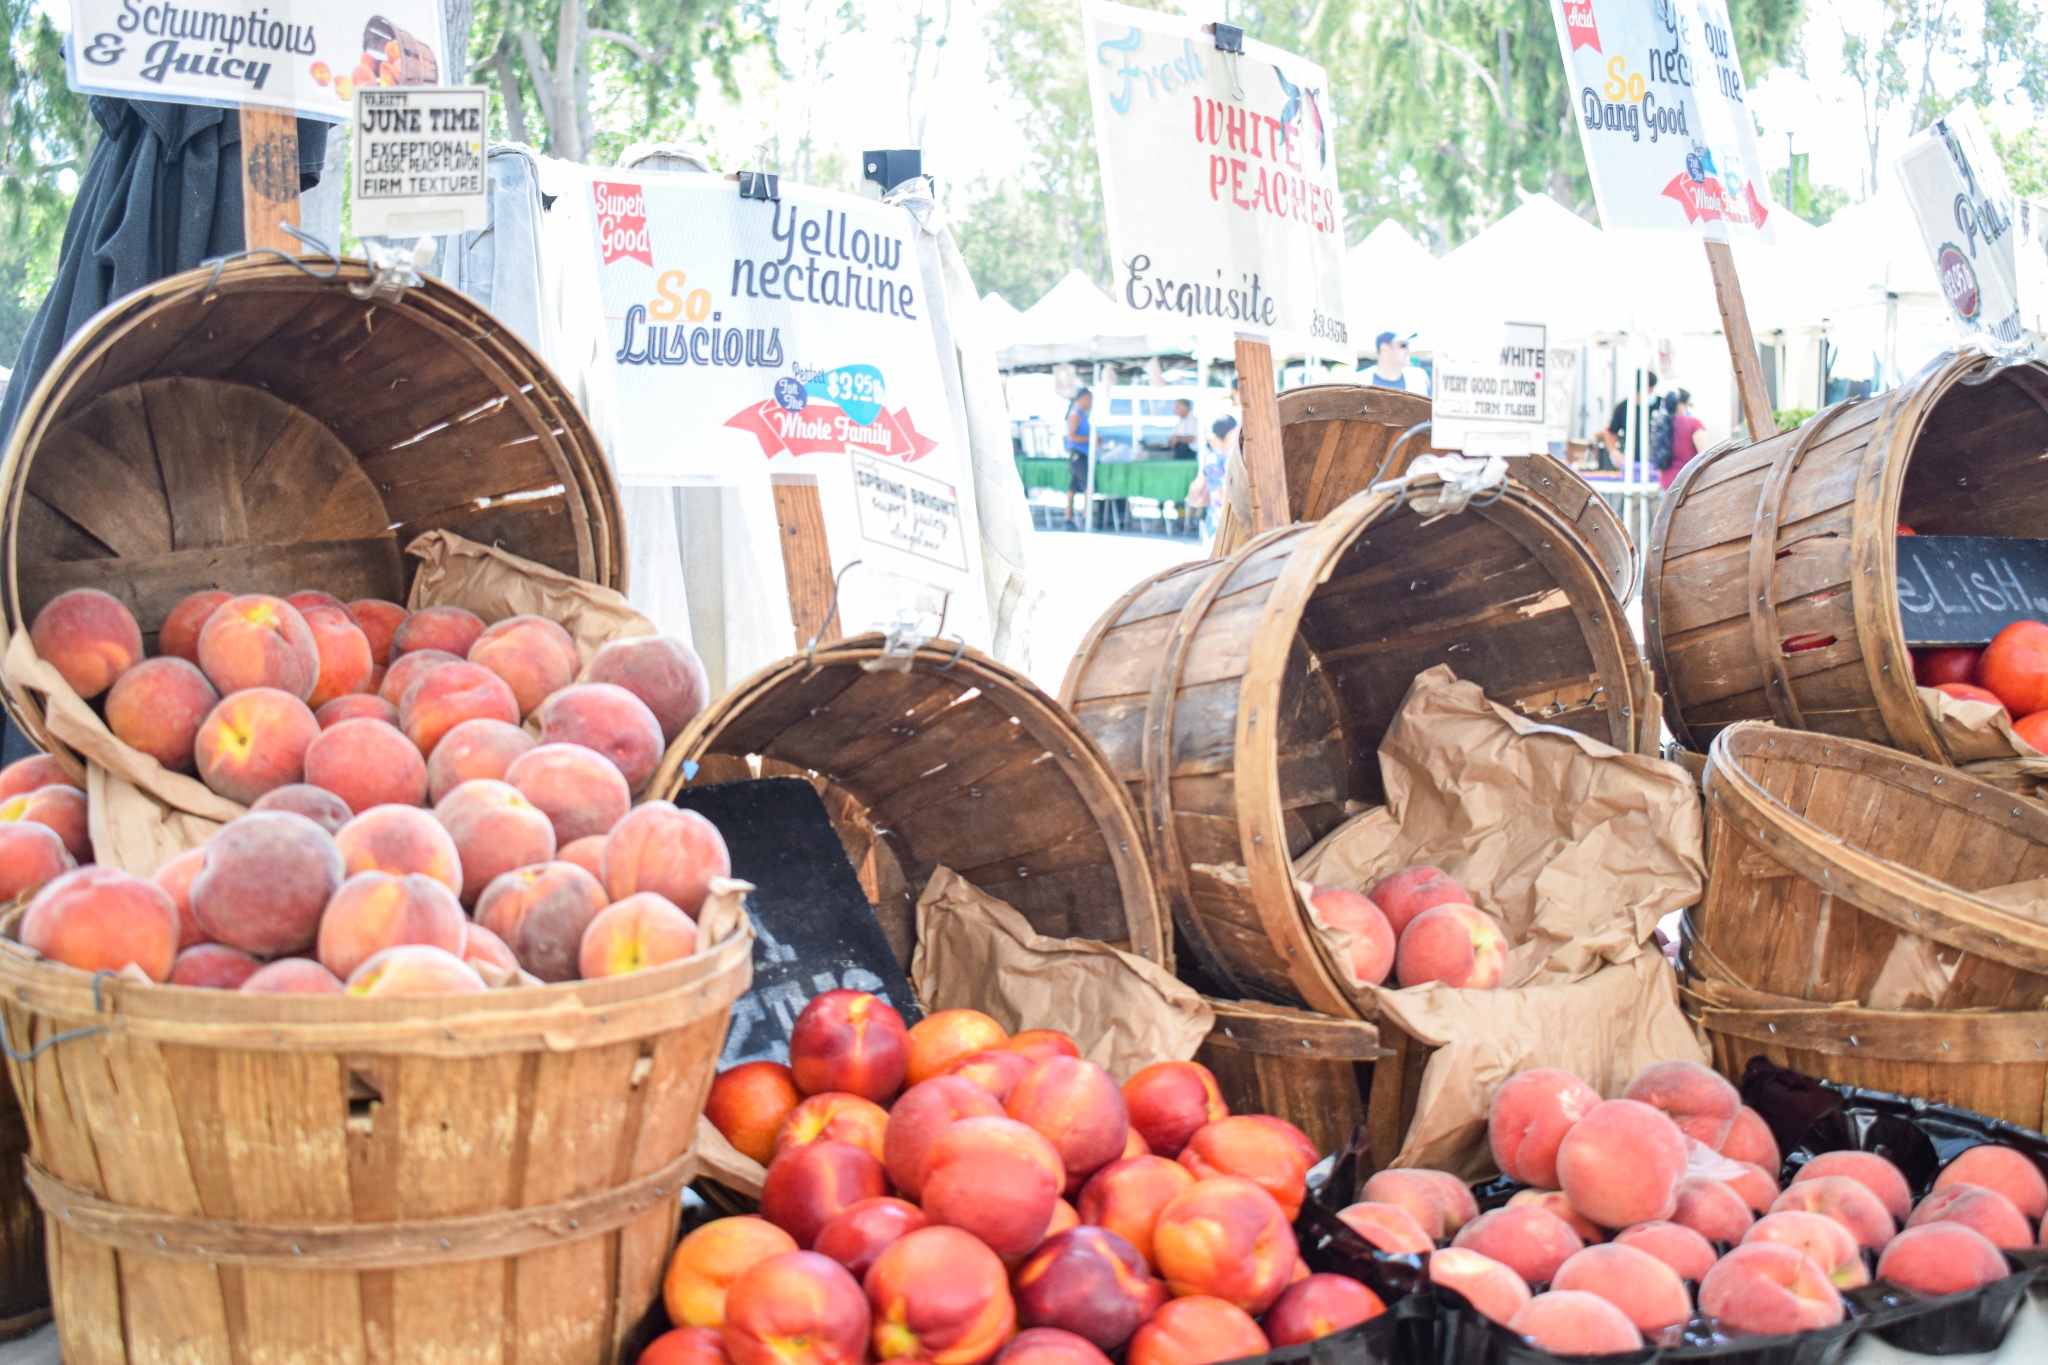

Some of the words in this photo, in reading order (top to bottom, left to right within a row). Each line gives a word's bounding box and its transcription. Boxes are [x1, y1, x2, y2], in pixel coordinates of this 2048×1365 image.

[117, 0, 317, 56] Scrumptious
[1568, 5, 1595, 28] Acid
[83, 33, 127, 66] &
[139, 39, 272, 90] Juicy
[1096, 26, 1206, 116] Fresh
[1604, 55, 1645, 103] So
[362, 108, 421, 133] JUNE
[429, 108, 480, 132] TIME
[364, 94, 408, 107] VARIETY
[1582, 87, 1640, 142] Dang
[1642, 91, 1689, 143] Good
[371, 141, 472, 159] EXCEPTIONAL
[1193, 96, 1302, 173] WHITE
[364, 158, 405, 174] CLASSIC
[409, 157, 440, 173] PEACH
[444, 156, 479, 172] FLAVOR
[364, 177, 402, 195] FIRM
[409, 175, 478, 193] TEXTURE
[596, 183, 646, 223] Super
[1209, 154, 1335, 234] PEACHES
[600, 216, 649, 258] Good
[648, 269, 712, 322] So
[731, 257, 917, 320] nectarine
[1122, 254, 1277, 326] Exquisite
[616, 304, 784, 367] Luscious
[792, 361, 826, 384] Perfect
[1500, 346, 1544, 368] WHITE
[779, 380, 799, 396] For
[784, 395, 804, 410] The
[1442, 374, 1467, 393] VERY
[1471, 377, 1497, 395] GOOD
[1501, 379, 1536, 398] FLAVOR
[1505, 403, 1536, 417] FLESH
[773, 412, 832, 440] Whole
[834, 416, 891, 452] Family
[857, 470, 907, 500] SPRING
[910, 487, 955, 518] BRIGHT
